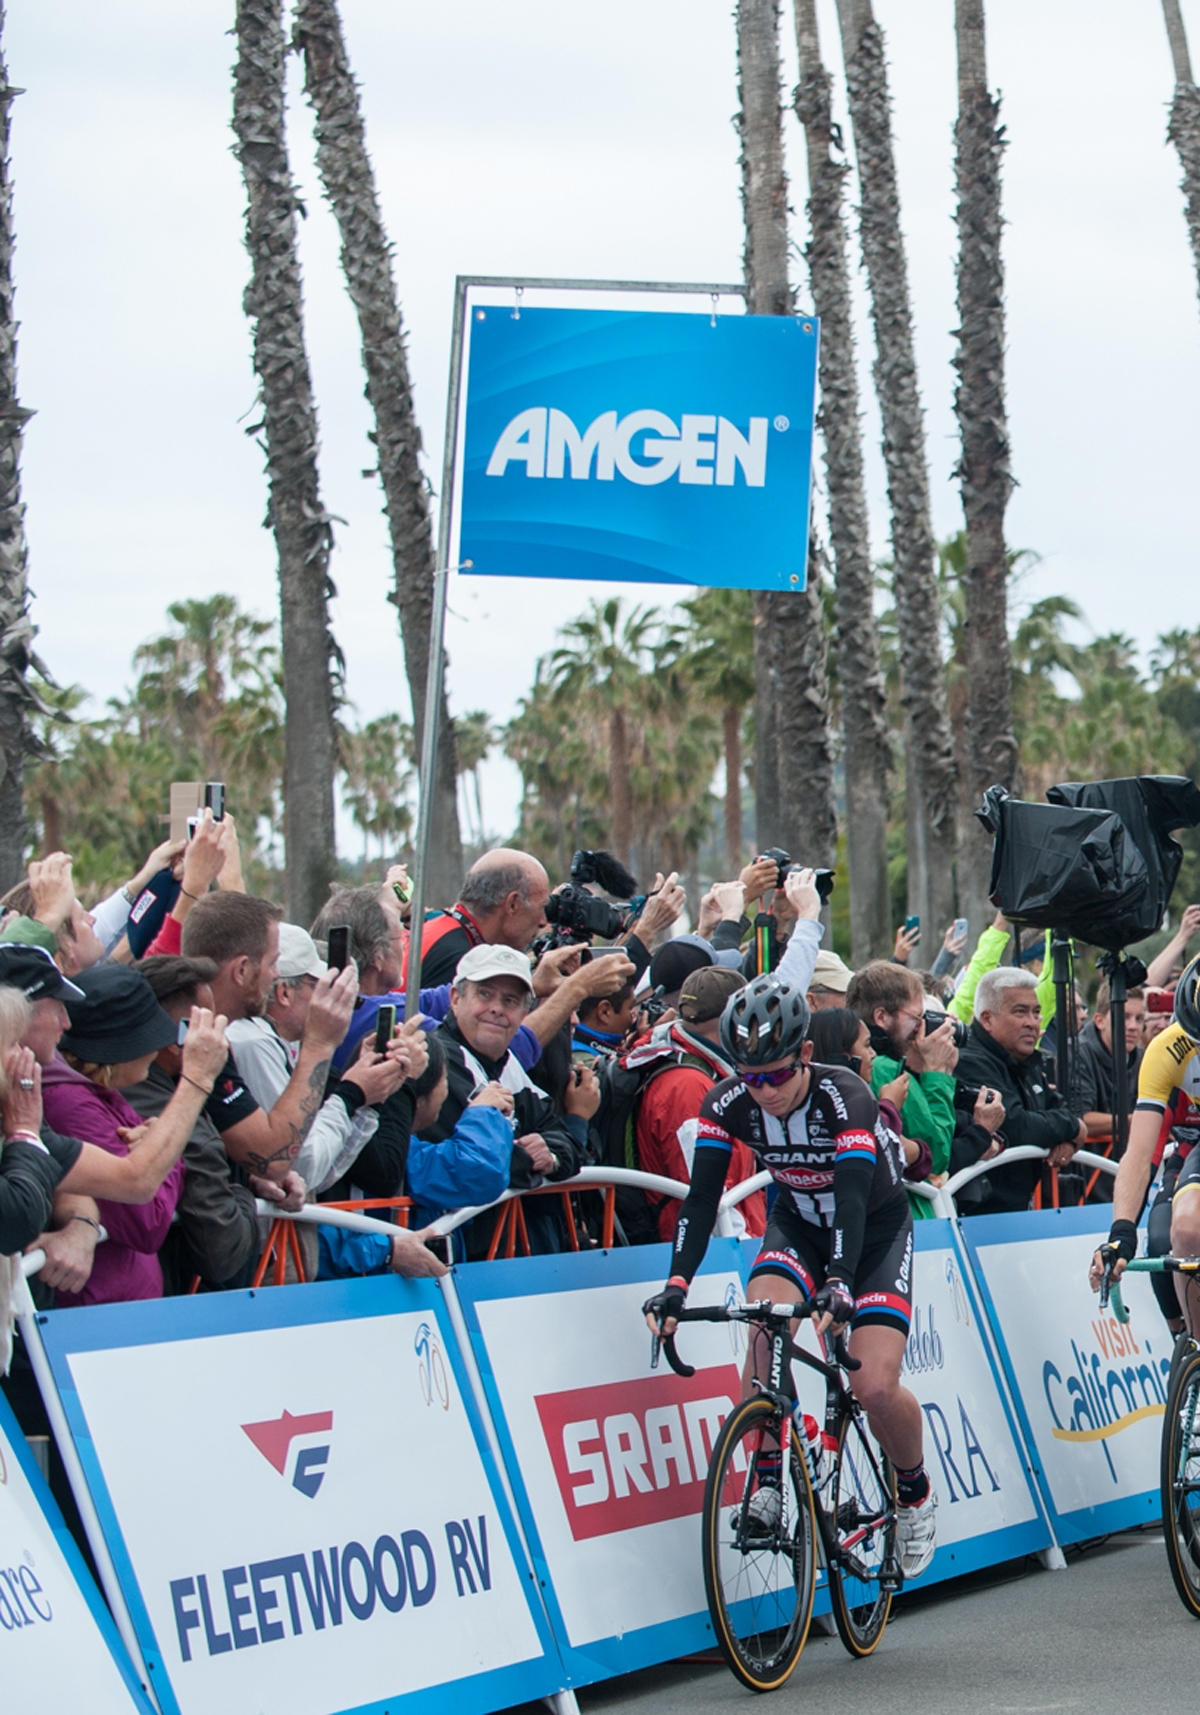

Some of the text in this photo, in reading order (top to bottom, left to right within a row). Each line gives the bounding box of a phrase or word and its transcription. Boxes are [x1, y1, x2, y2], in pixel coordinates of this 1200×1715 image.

[826, 1084, 848, 1121] GIANT
[763, 1152, 836, 1164] GIANT
[764, 1250, 808, 1279] Alpecin
[1091, 1305, 1140, 1361] visit
[770, 1334, 784, 1390] GIANT
[562, 1395, 749, 1508] SRAM
[169, 1515, 493, 1663] FLEETWOOD RV
